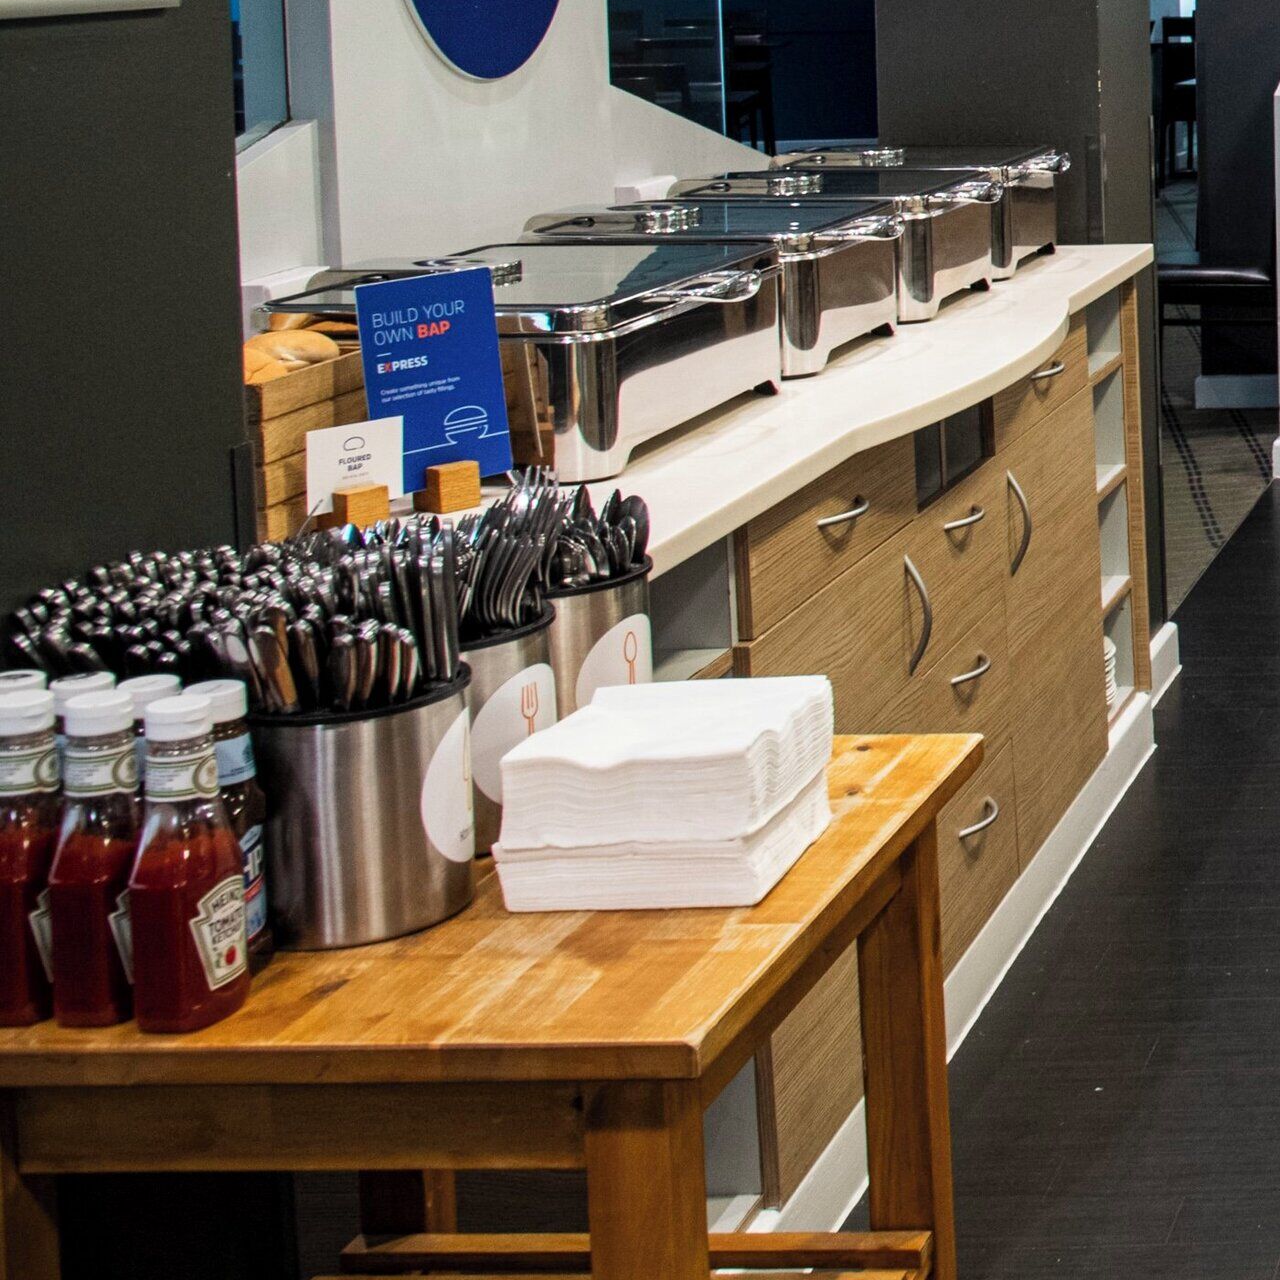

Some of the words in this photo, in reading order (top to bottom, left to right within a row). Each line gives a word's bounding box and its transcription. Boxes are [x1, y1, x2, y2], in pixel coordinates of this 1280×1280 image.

[372, 307, 419, 328] BUILD
[422, 299, 465, 320] YOUR
[374, 326, 414, 346] OWN
[416, 320, 451, 339] BAP
[377, 355, 428, 374] EXPRESS
[338, 453, 372, 465] FLOURED
[347, 462, 363, 472] BAP
